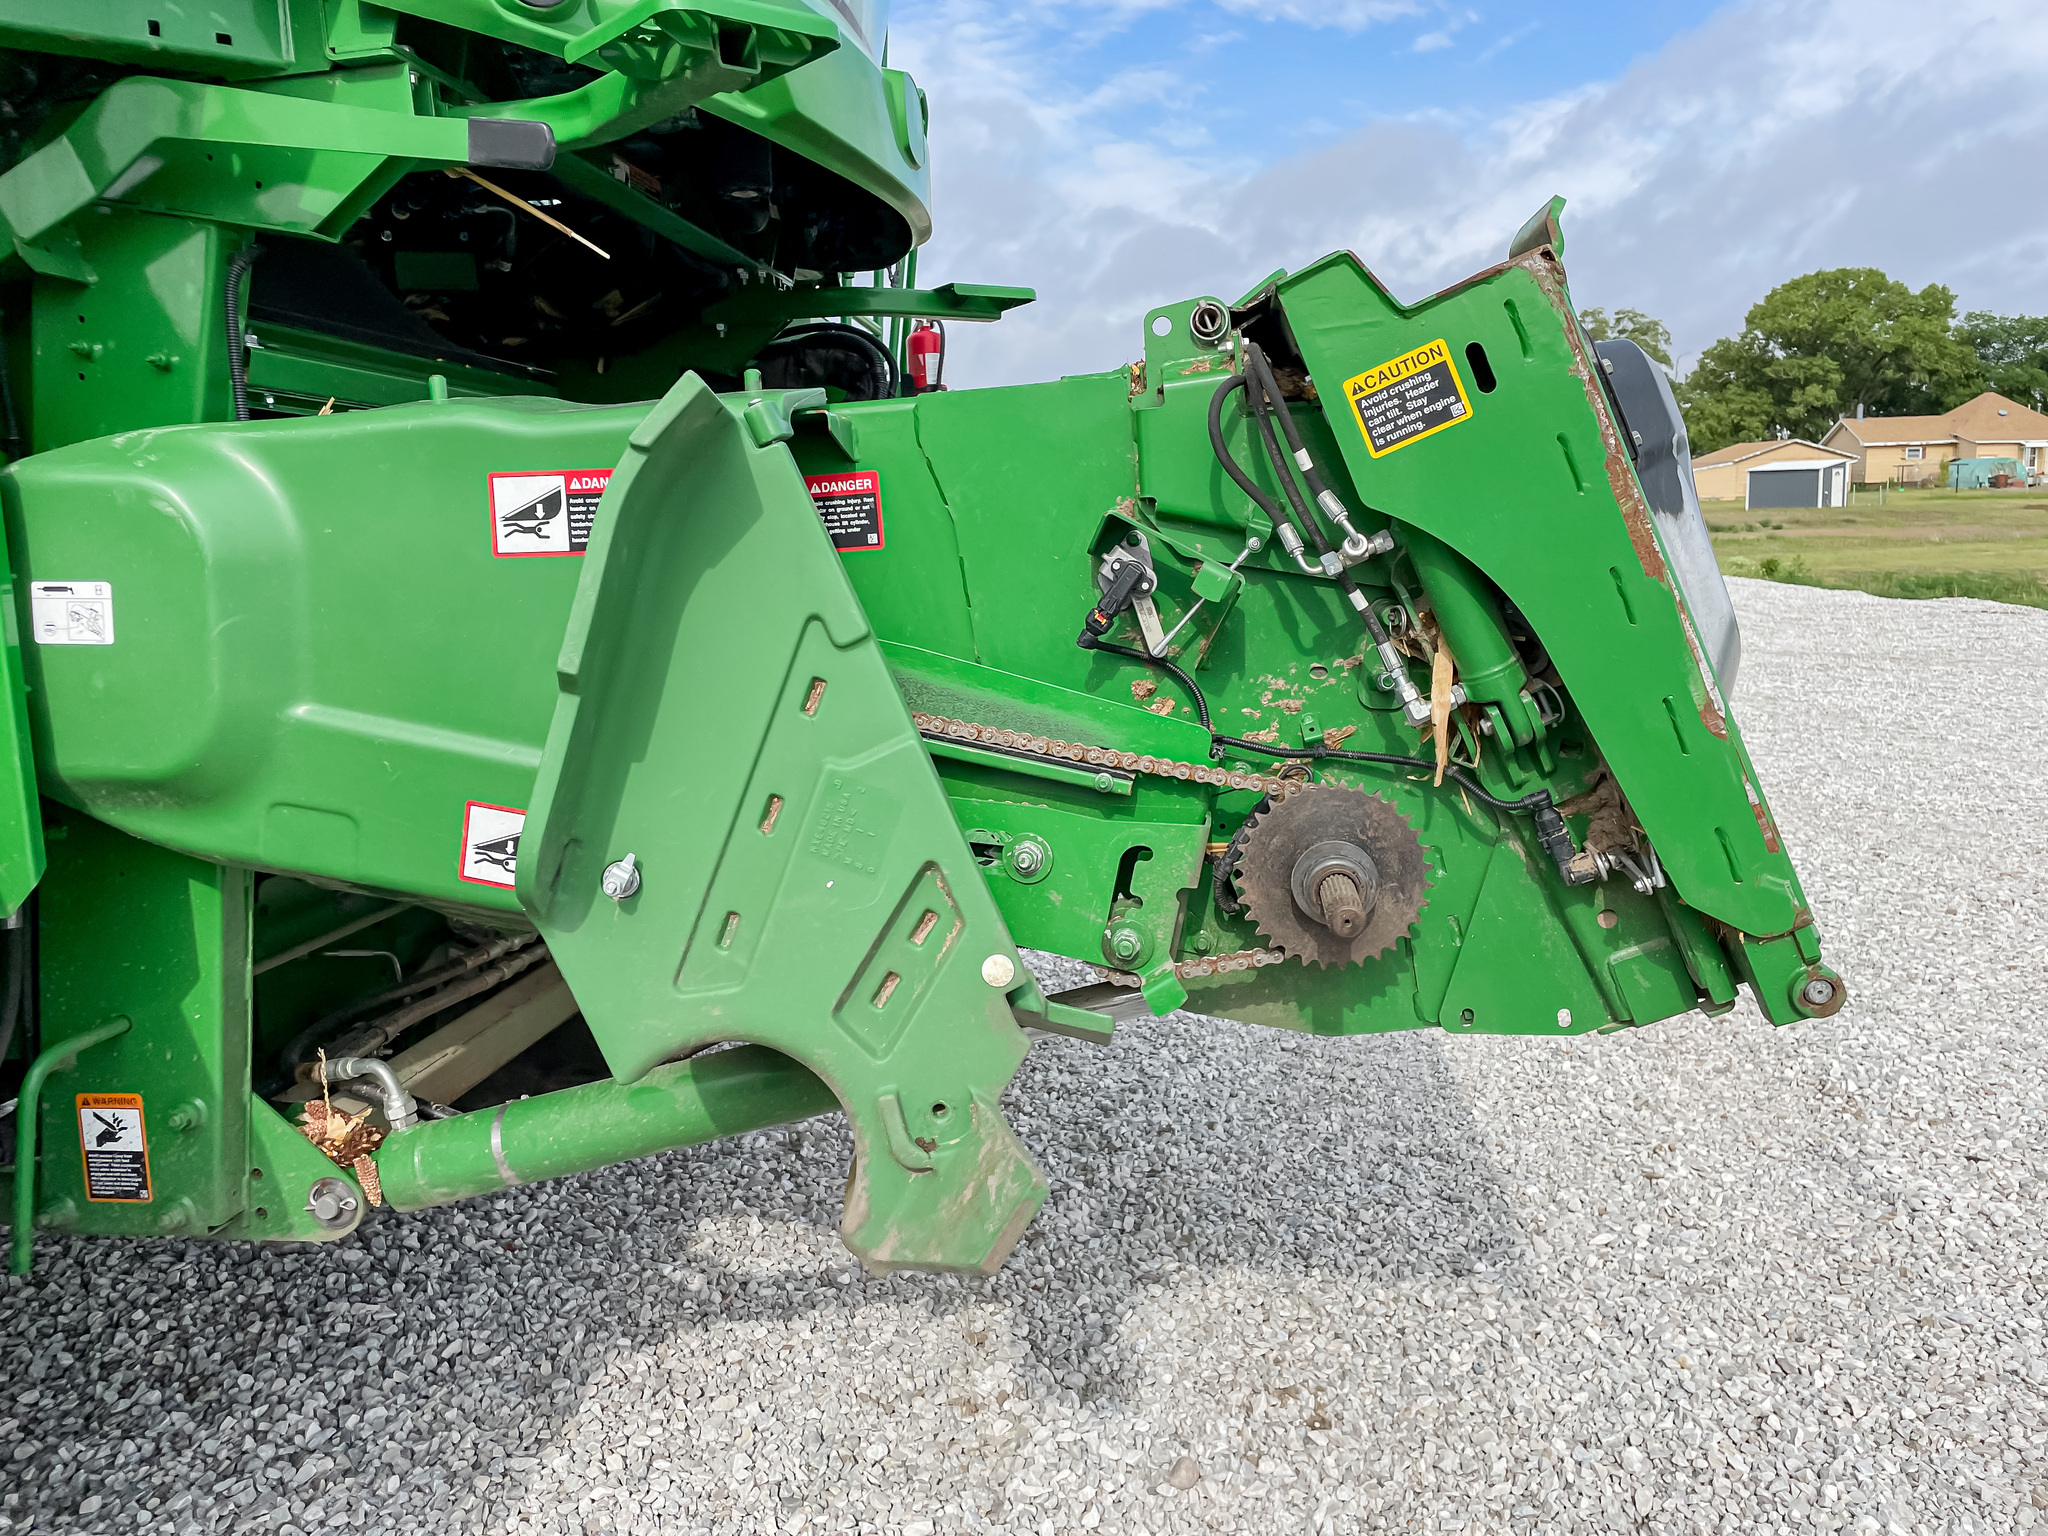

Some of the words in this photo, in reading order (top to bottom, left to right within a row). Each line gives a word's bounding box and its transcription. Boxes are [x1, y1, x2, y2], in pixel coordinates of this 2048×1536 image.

[1364, 344, 1443, 389] CAUTION
[1361, 390, 1389, 409] Avoid
[1389, 371, 1432, 395] crushing
[1363, 397, 1402, 418] injuries.
[1405, 379, 1440, 400] Header
[1368, 415, 1386, 427] can
[1386, 407, 1403, 420] tilt.
[1406, 395, 1428, 411] Stay
[1372, 420, 1395, 437] clear
[1396, 410, 1422, 426] when
[1423, 395, 1457, 414] engine
[1375, 437, 1385, 447] is
[1386, 421, 1426, 443] running.
[581, 477, 610, 489] DAN
[821, 478, 873, 493] DANGER
[837, 792, 852, 813] USA
[92, 1097, 138, 1105] WARNING
